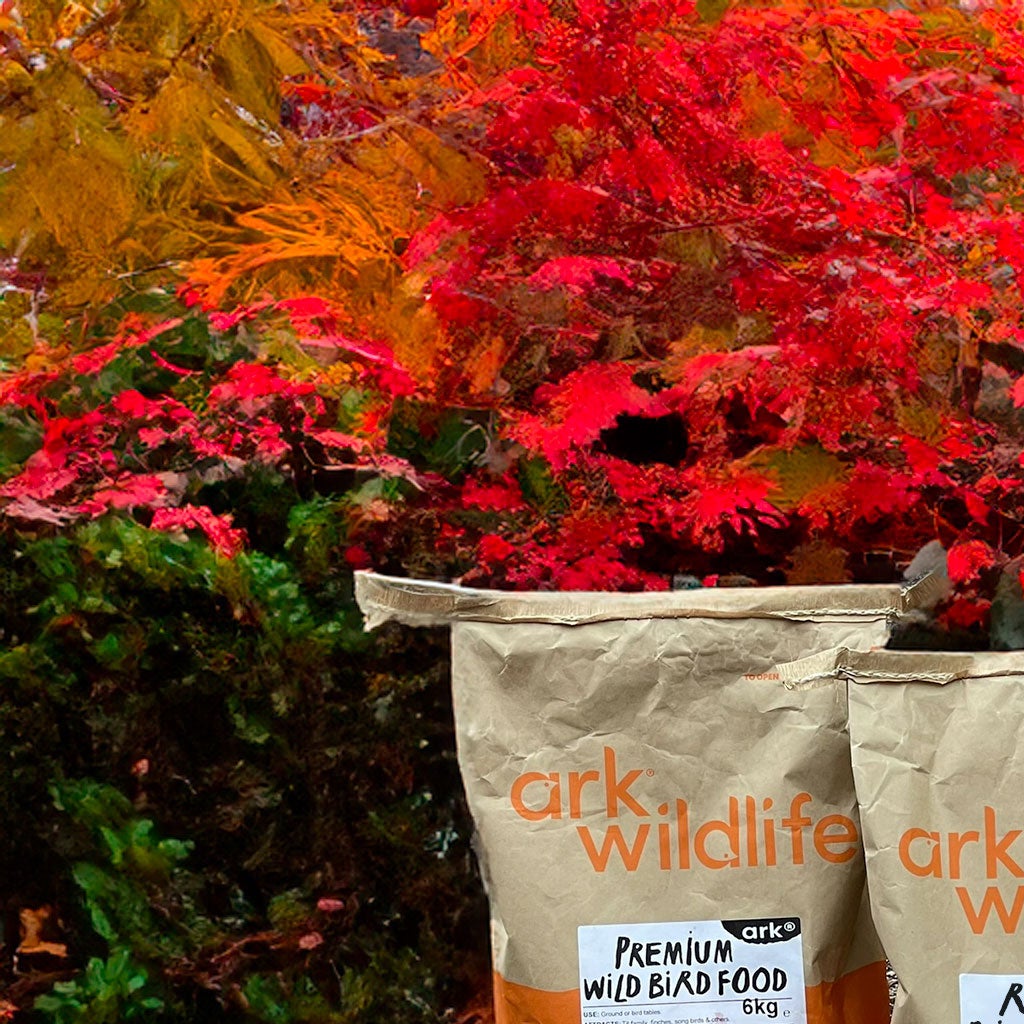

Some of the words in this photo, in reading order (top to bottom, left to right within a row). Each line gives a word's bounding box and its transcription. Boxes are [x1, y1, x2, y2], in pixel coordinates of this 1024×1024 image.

[576, 792, 858, 872] wildlife
[615, 930, 733, 969] PREMIUM
[584, 973, 641, 1002] WILD
[649, 970, 711, 998] BIRD
[718, 967, 787, 995] FOOD
[743, 998, 778, 1018] 6kg
